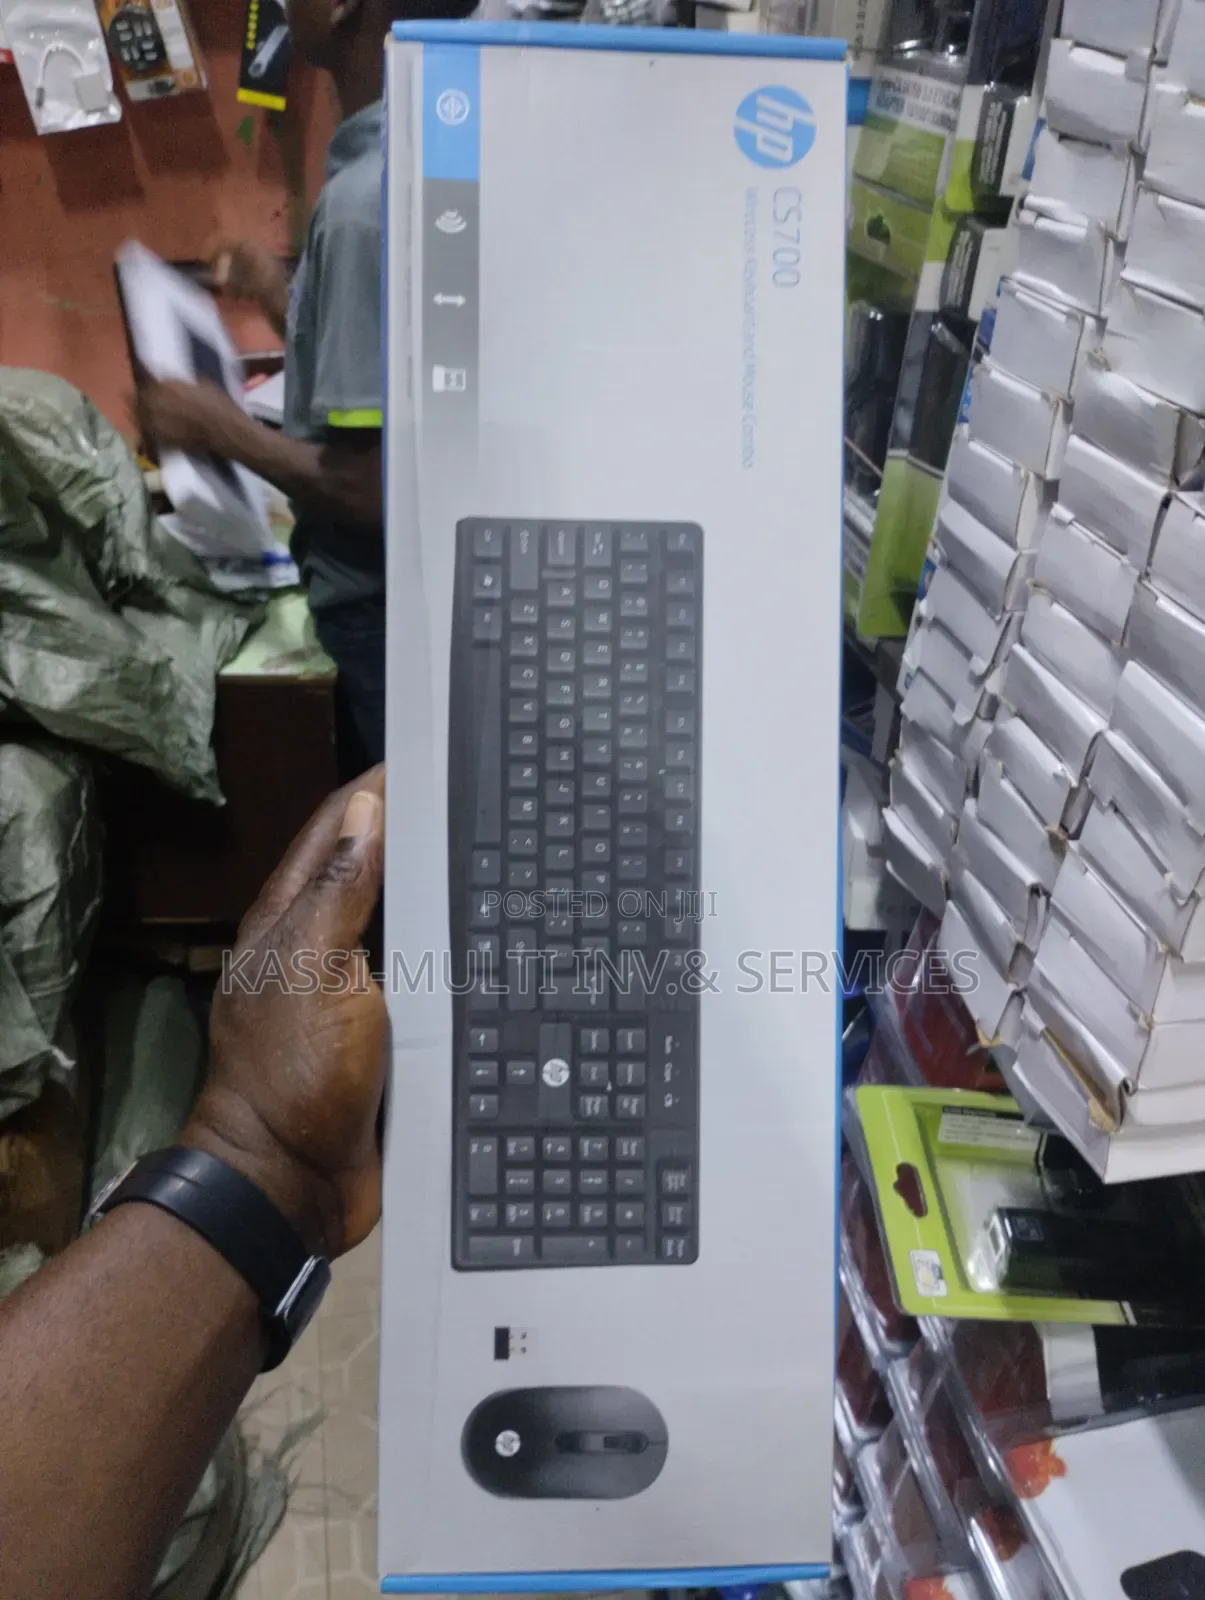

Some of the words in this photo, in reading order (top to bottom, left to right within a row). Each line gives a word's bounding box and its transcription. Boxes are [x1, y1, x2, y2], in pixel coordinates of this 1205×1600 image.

[734, 86, 816, 167] hp
[772, 186, 802, 288] CS700
[742, 257, 758, 330] Keyboard
[743, 331, 757, 360] and
[743, 364, 757, 409] Mouse
[741, 415, 757, 468] Combo
